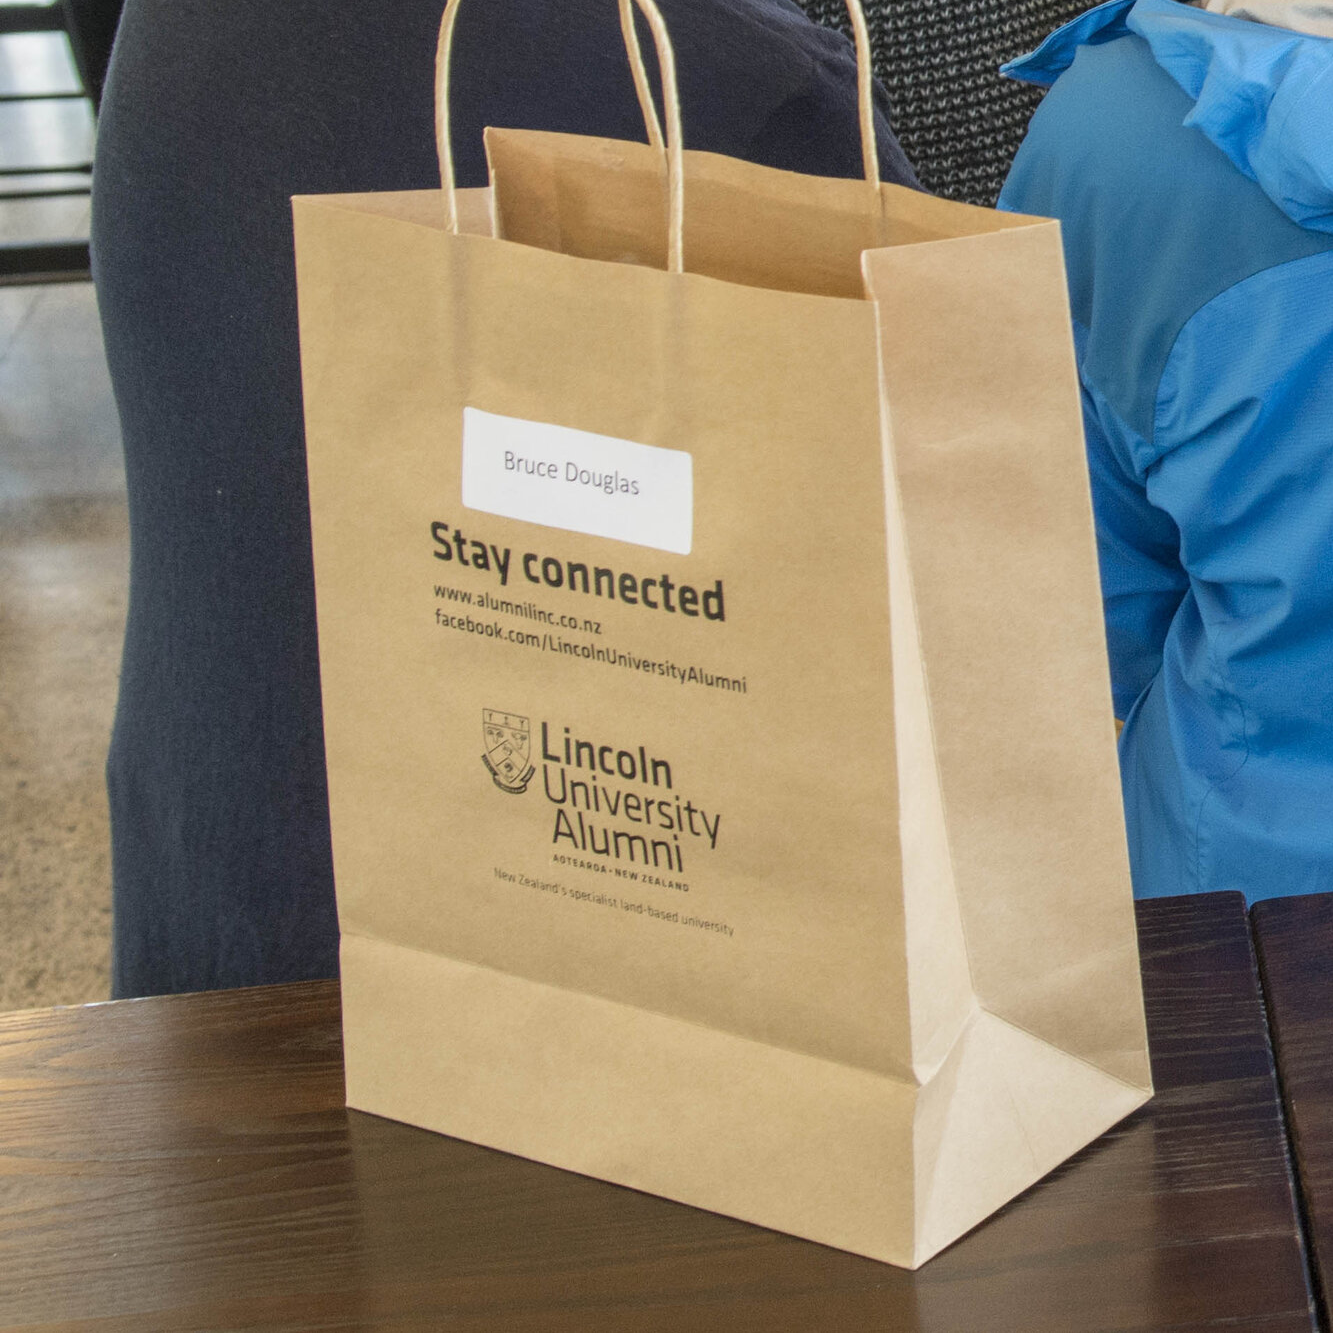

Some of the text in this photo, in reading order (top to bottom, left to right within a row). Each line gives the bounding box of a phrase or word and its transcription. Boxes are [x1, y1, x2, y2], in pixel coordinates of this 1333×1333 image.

[504, 450, 640, 495] Bruce Douglas
[430, 520, 727, 622] Stay connected
[434, 585, 602, 635] www.alumnilinc.co.nz
[434, 608, 748, 694] facebook.com/LincolnUniversityAlumni
[540, 721, 673, 789] Lincoln
[542, 763, 720, 850] University
[552, 808, 684, 873] Alumni
[493, 866, 735, 938] New Zealand's specialist land-based university
[552, 853, 690, 893] AOTEAROA NEW ZEALAND
